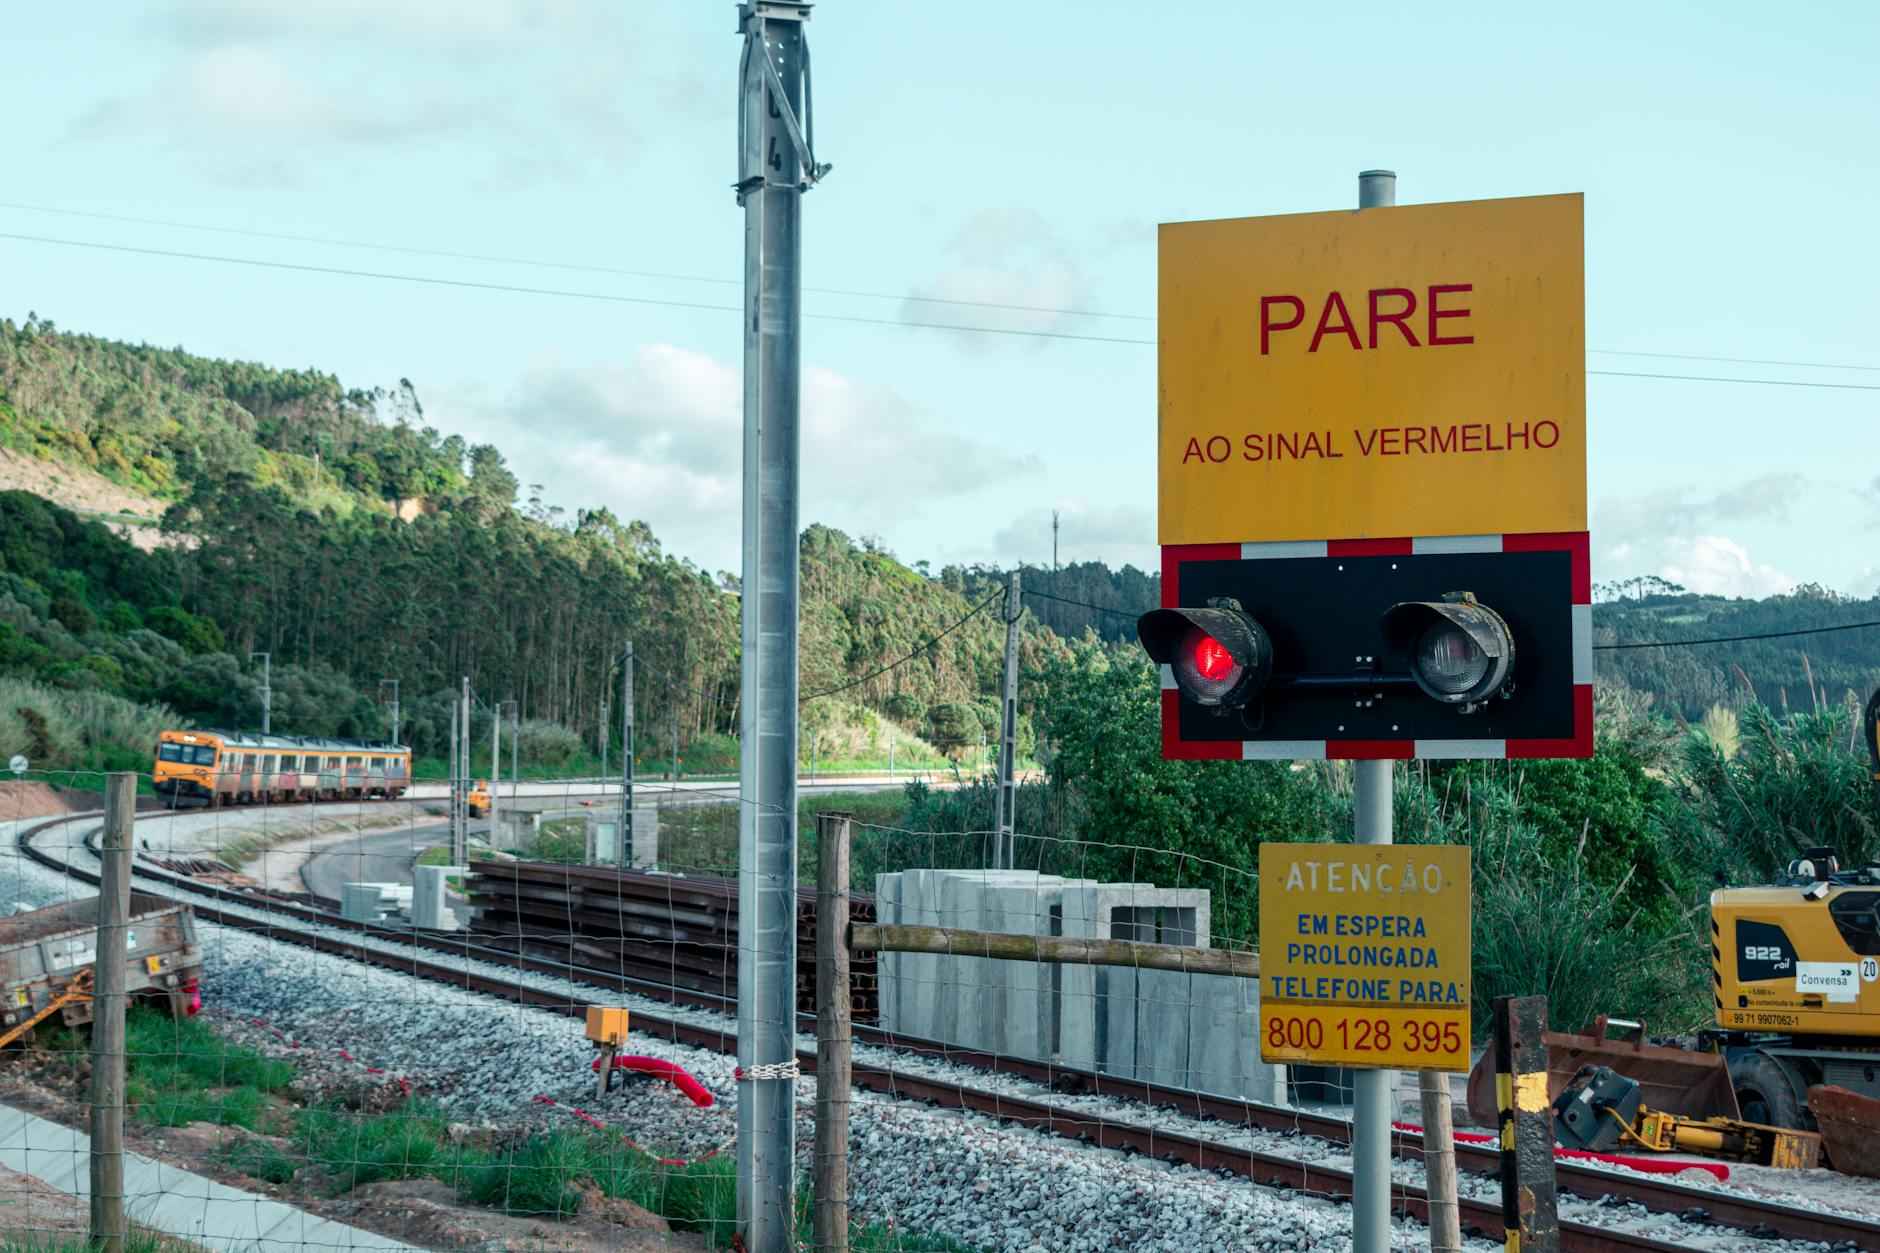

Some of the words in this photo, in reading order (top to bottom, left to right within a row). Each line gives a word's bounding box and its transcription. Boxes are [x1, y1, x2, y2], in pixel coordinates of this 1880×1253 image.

[1260, 283, 1475, 355] PARE
[1182, 436, 1231, 464] AO
[1243, 431, 1343, 461] SINAL
[1354, 420, 1560, 456] VERMELHO
[1298, 914, 1328, 935] EM
[1335, 915, 1426, 937] ESPERA
[1287, 943, 1439, 968] PROLONGADA
[1745, 946, 1781, 960] 922
[1801, 974, 1847, 986] Convensa
[1863, 961, 1876, 977] 20
[1272, 976, 1392, 1000] TELEFONE
[1268, 1017, 1323, 1049] 800
[1336, 1018, 1391, 1050] 128
[1403, 1020, 1461, 1053] 395
